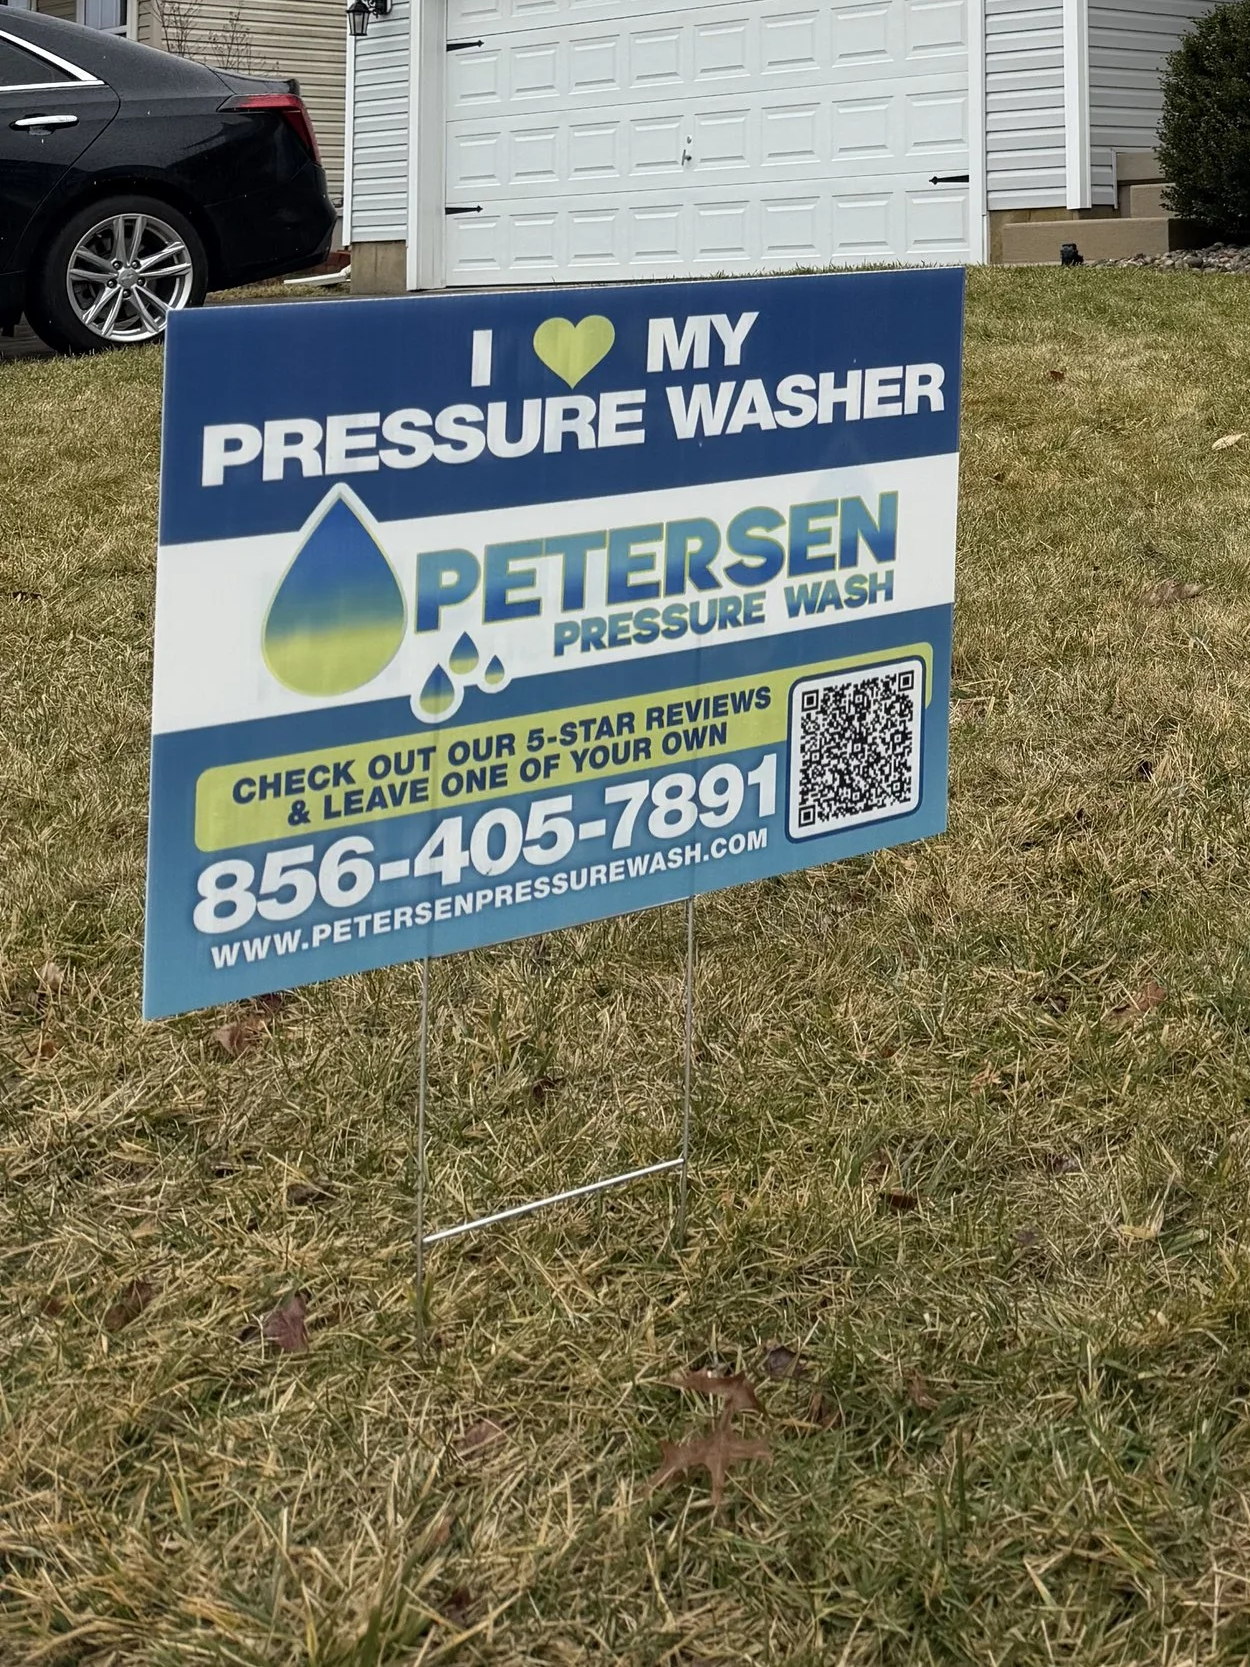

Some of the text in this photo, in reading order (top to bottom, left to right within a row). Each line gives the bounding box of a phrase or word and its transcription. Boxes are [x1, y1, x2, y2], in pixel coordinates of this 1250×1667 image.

[471, 312, 759, 387] I MY
[201, 363, 944, 486] PRESSURE WASHER
[415, 491, 899, 632] PETERSEN
[554, 570, 895, 656] PRESSURE WASH
[232, 686, 772, 805] CHECK OUT OUR 5-STAR REVIEWS
[288, 722, 728, 825] & LEAVE ONE OF YOUR OWN
[193, 754, 777, 934] 856-405-7891
[211, 828, 768, 970] WWW.PETERSENPRESSUREWASH.COM
